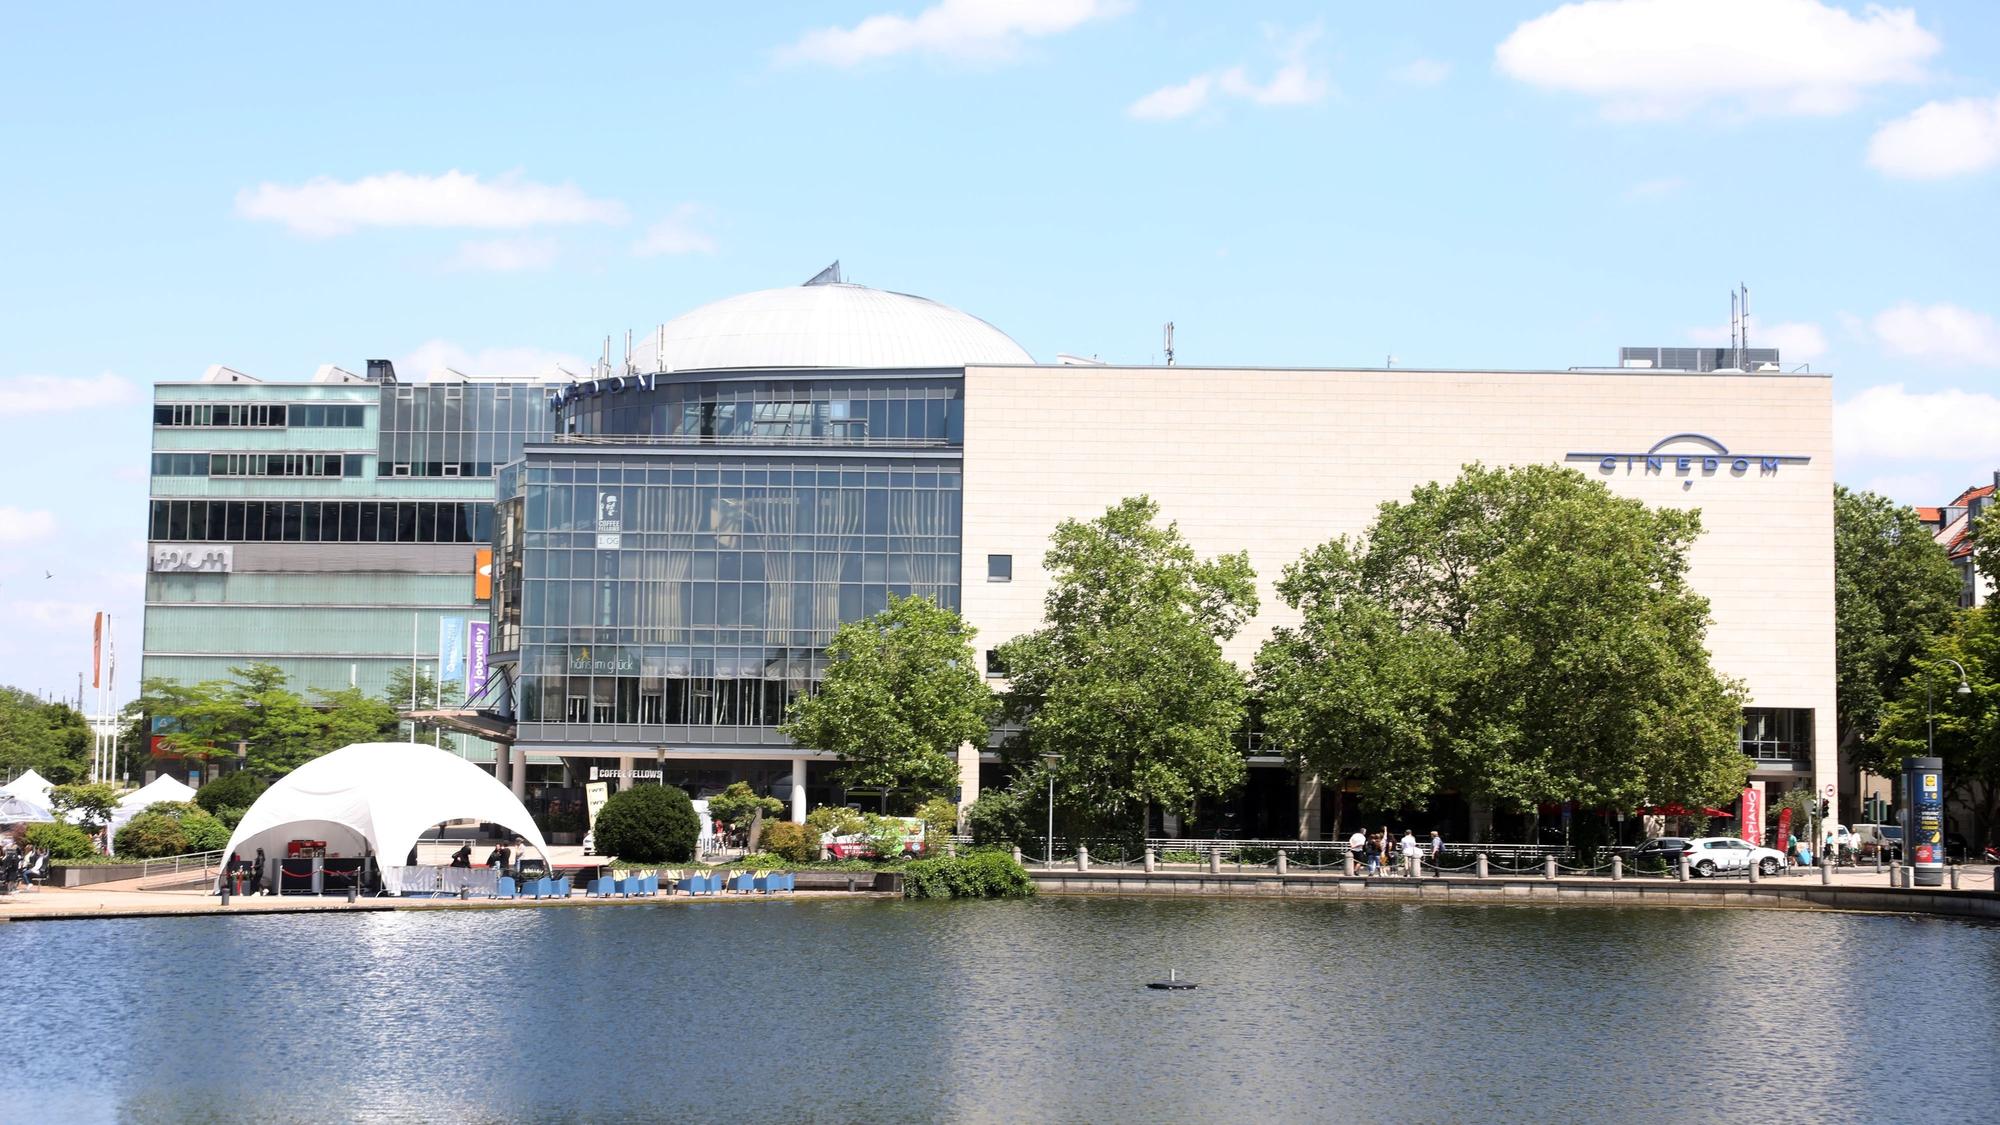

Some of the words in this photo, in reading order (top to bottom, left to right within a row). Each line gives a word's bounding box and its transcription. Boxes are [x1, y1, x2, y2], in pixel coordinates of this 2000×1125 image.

[1600, 455, 1780, 471] CINEDOM
[599, 769, 627, 778] COFFEE
[628, 769, 661, 779] FELLOWS
[1745, 791, 1758, 845] APIANO
